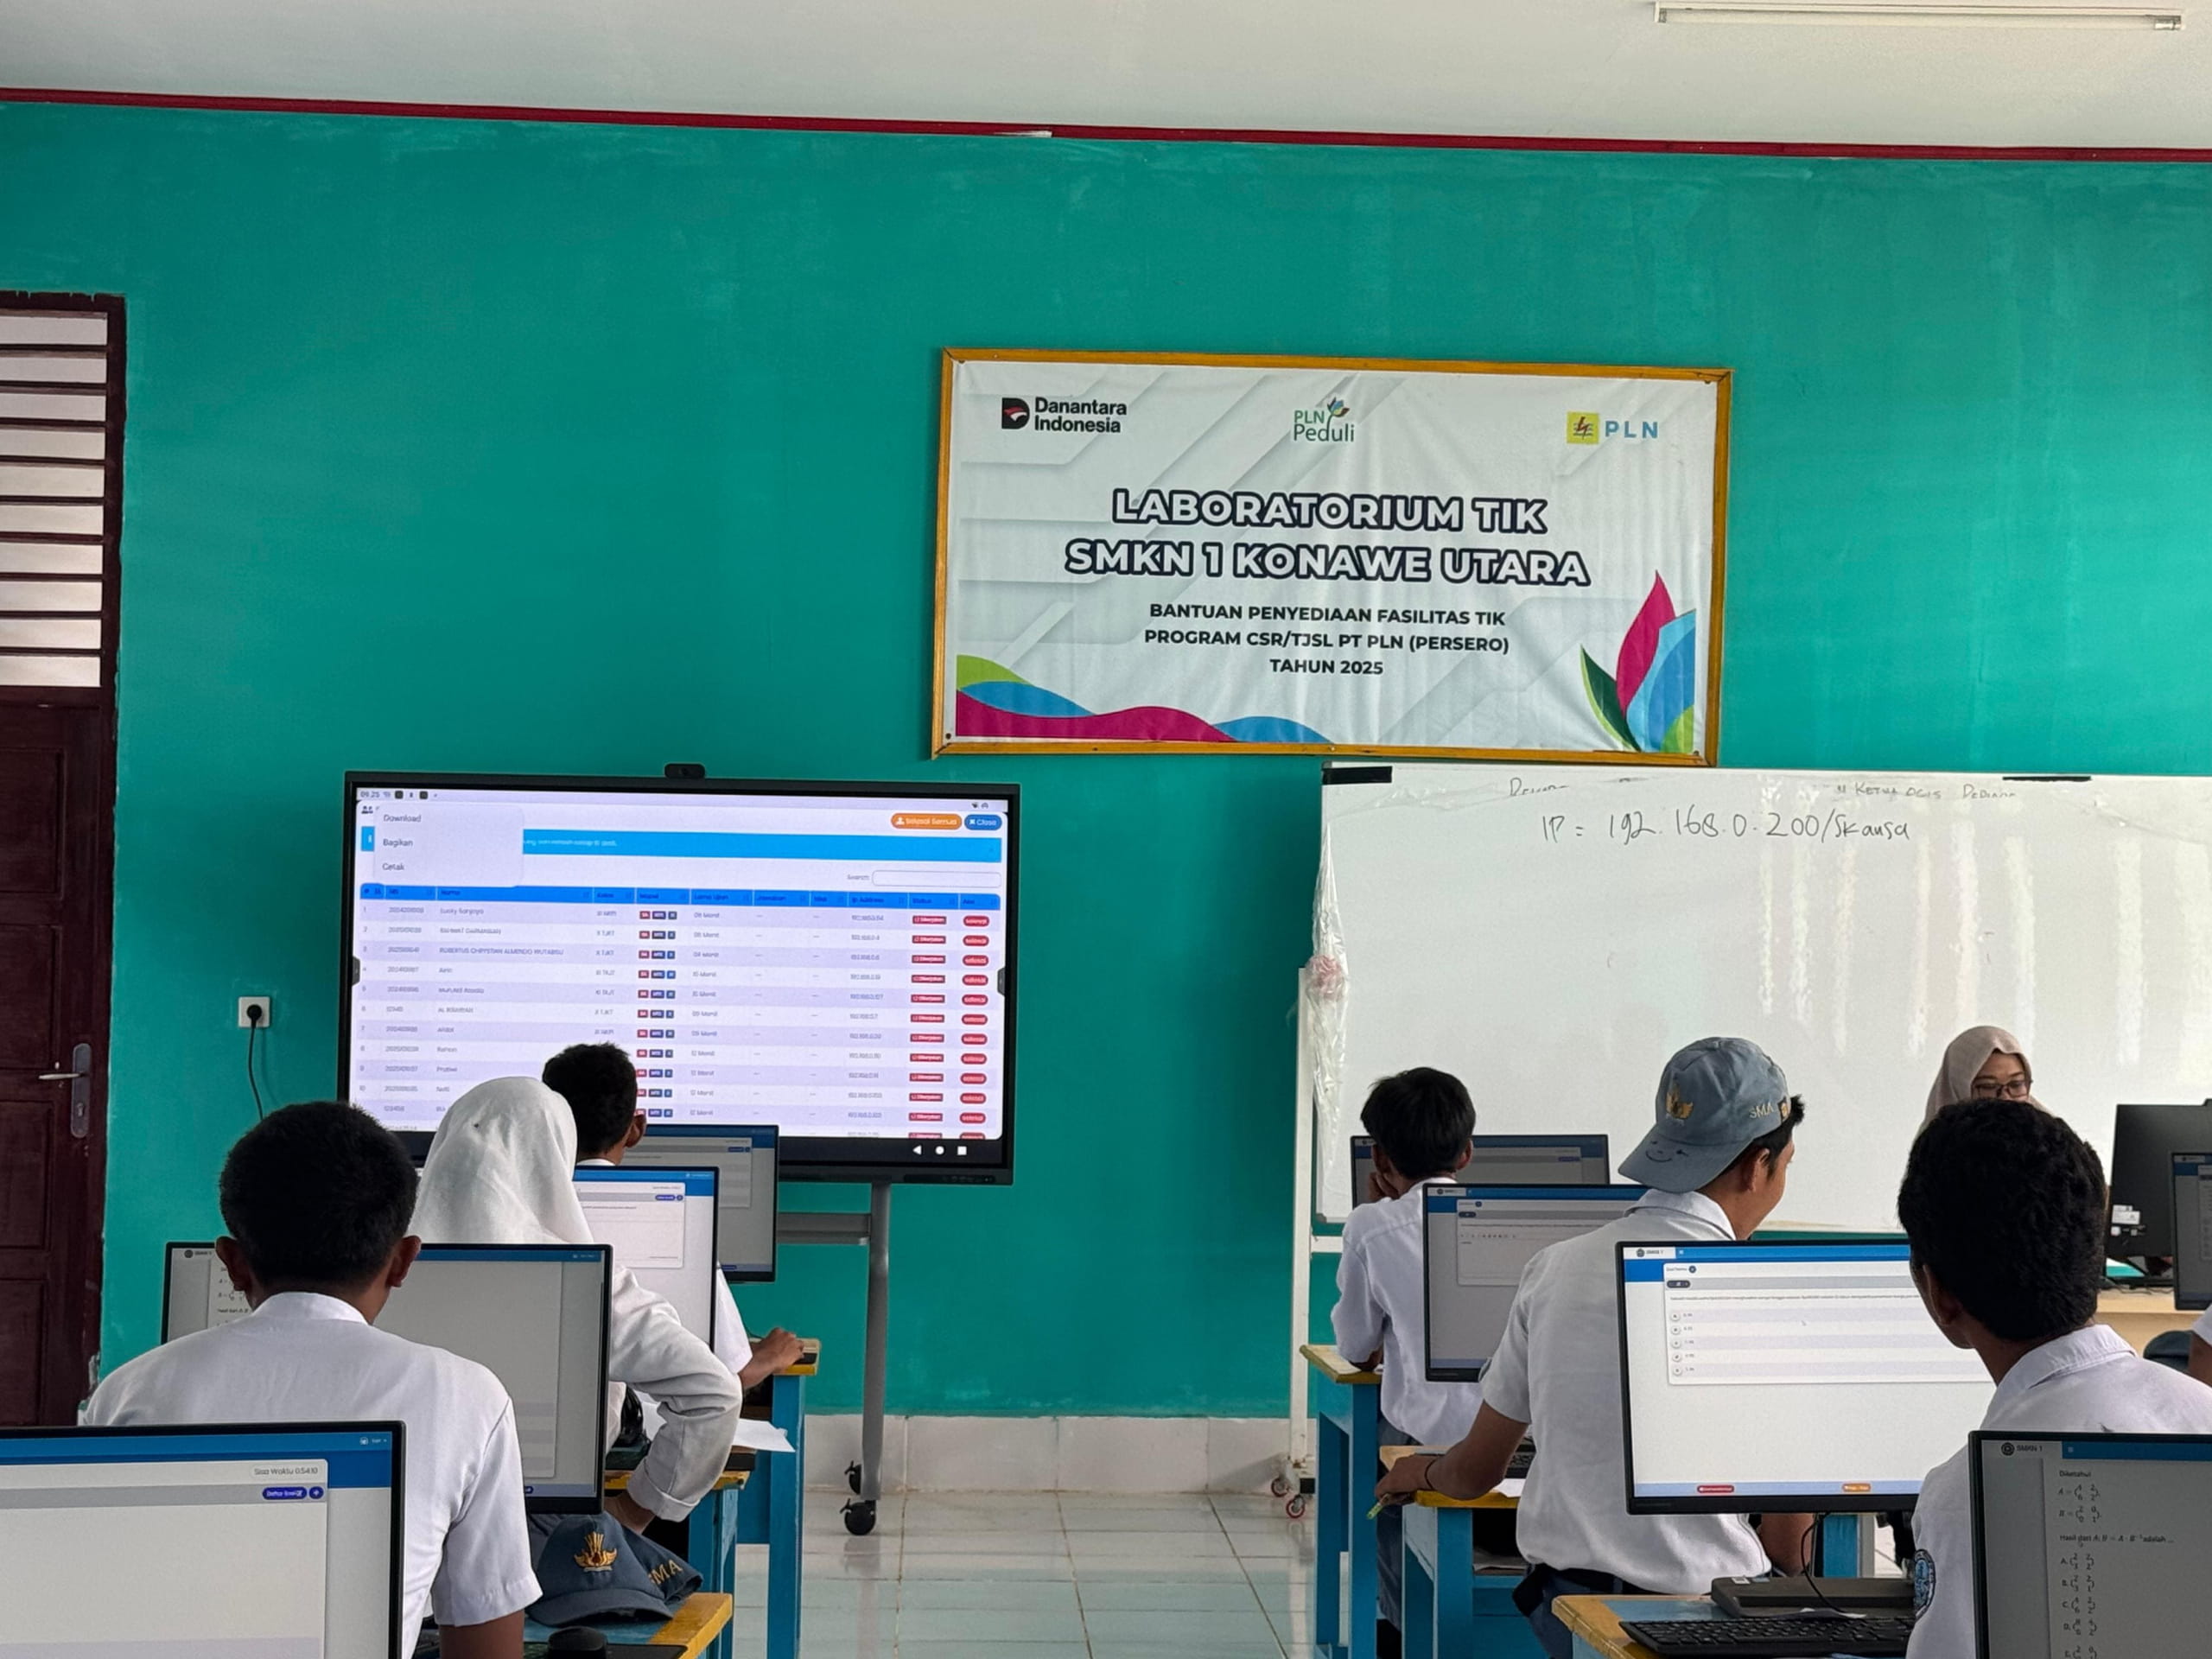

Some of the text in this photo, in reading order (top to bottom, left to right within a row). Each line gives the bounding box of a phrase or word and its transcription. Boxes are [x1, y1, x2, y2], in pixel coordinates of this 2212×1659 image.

[1035, 397, 1127, 415] Danantara
[1034, 416, 1121, 433] Indonesia
[1294, 410, 1325, 423] PLN
[1294, 423, 1354, 442] Peduli
[1605, 421, 1658, 438] PLN
[1112, 488, 1548, 534] LABORATORIUM TIK
[1065, 538, 1592, 586] SMKN 1 KONAWE UTARA
[1150, 604, 1505, 626] BANTUAN PENYEDIAAN FASILITAS TIK
[1145, 630, 1509, 655] PROGRAM CSR/TJSL PT PLN (PERSERO)
[1269, 659, 1383, 674] TAHUN 2025
[1749, 1102, 1775, 1120] SMA
